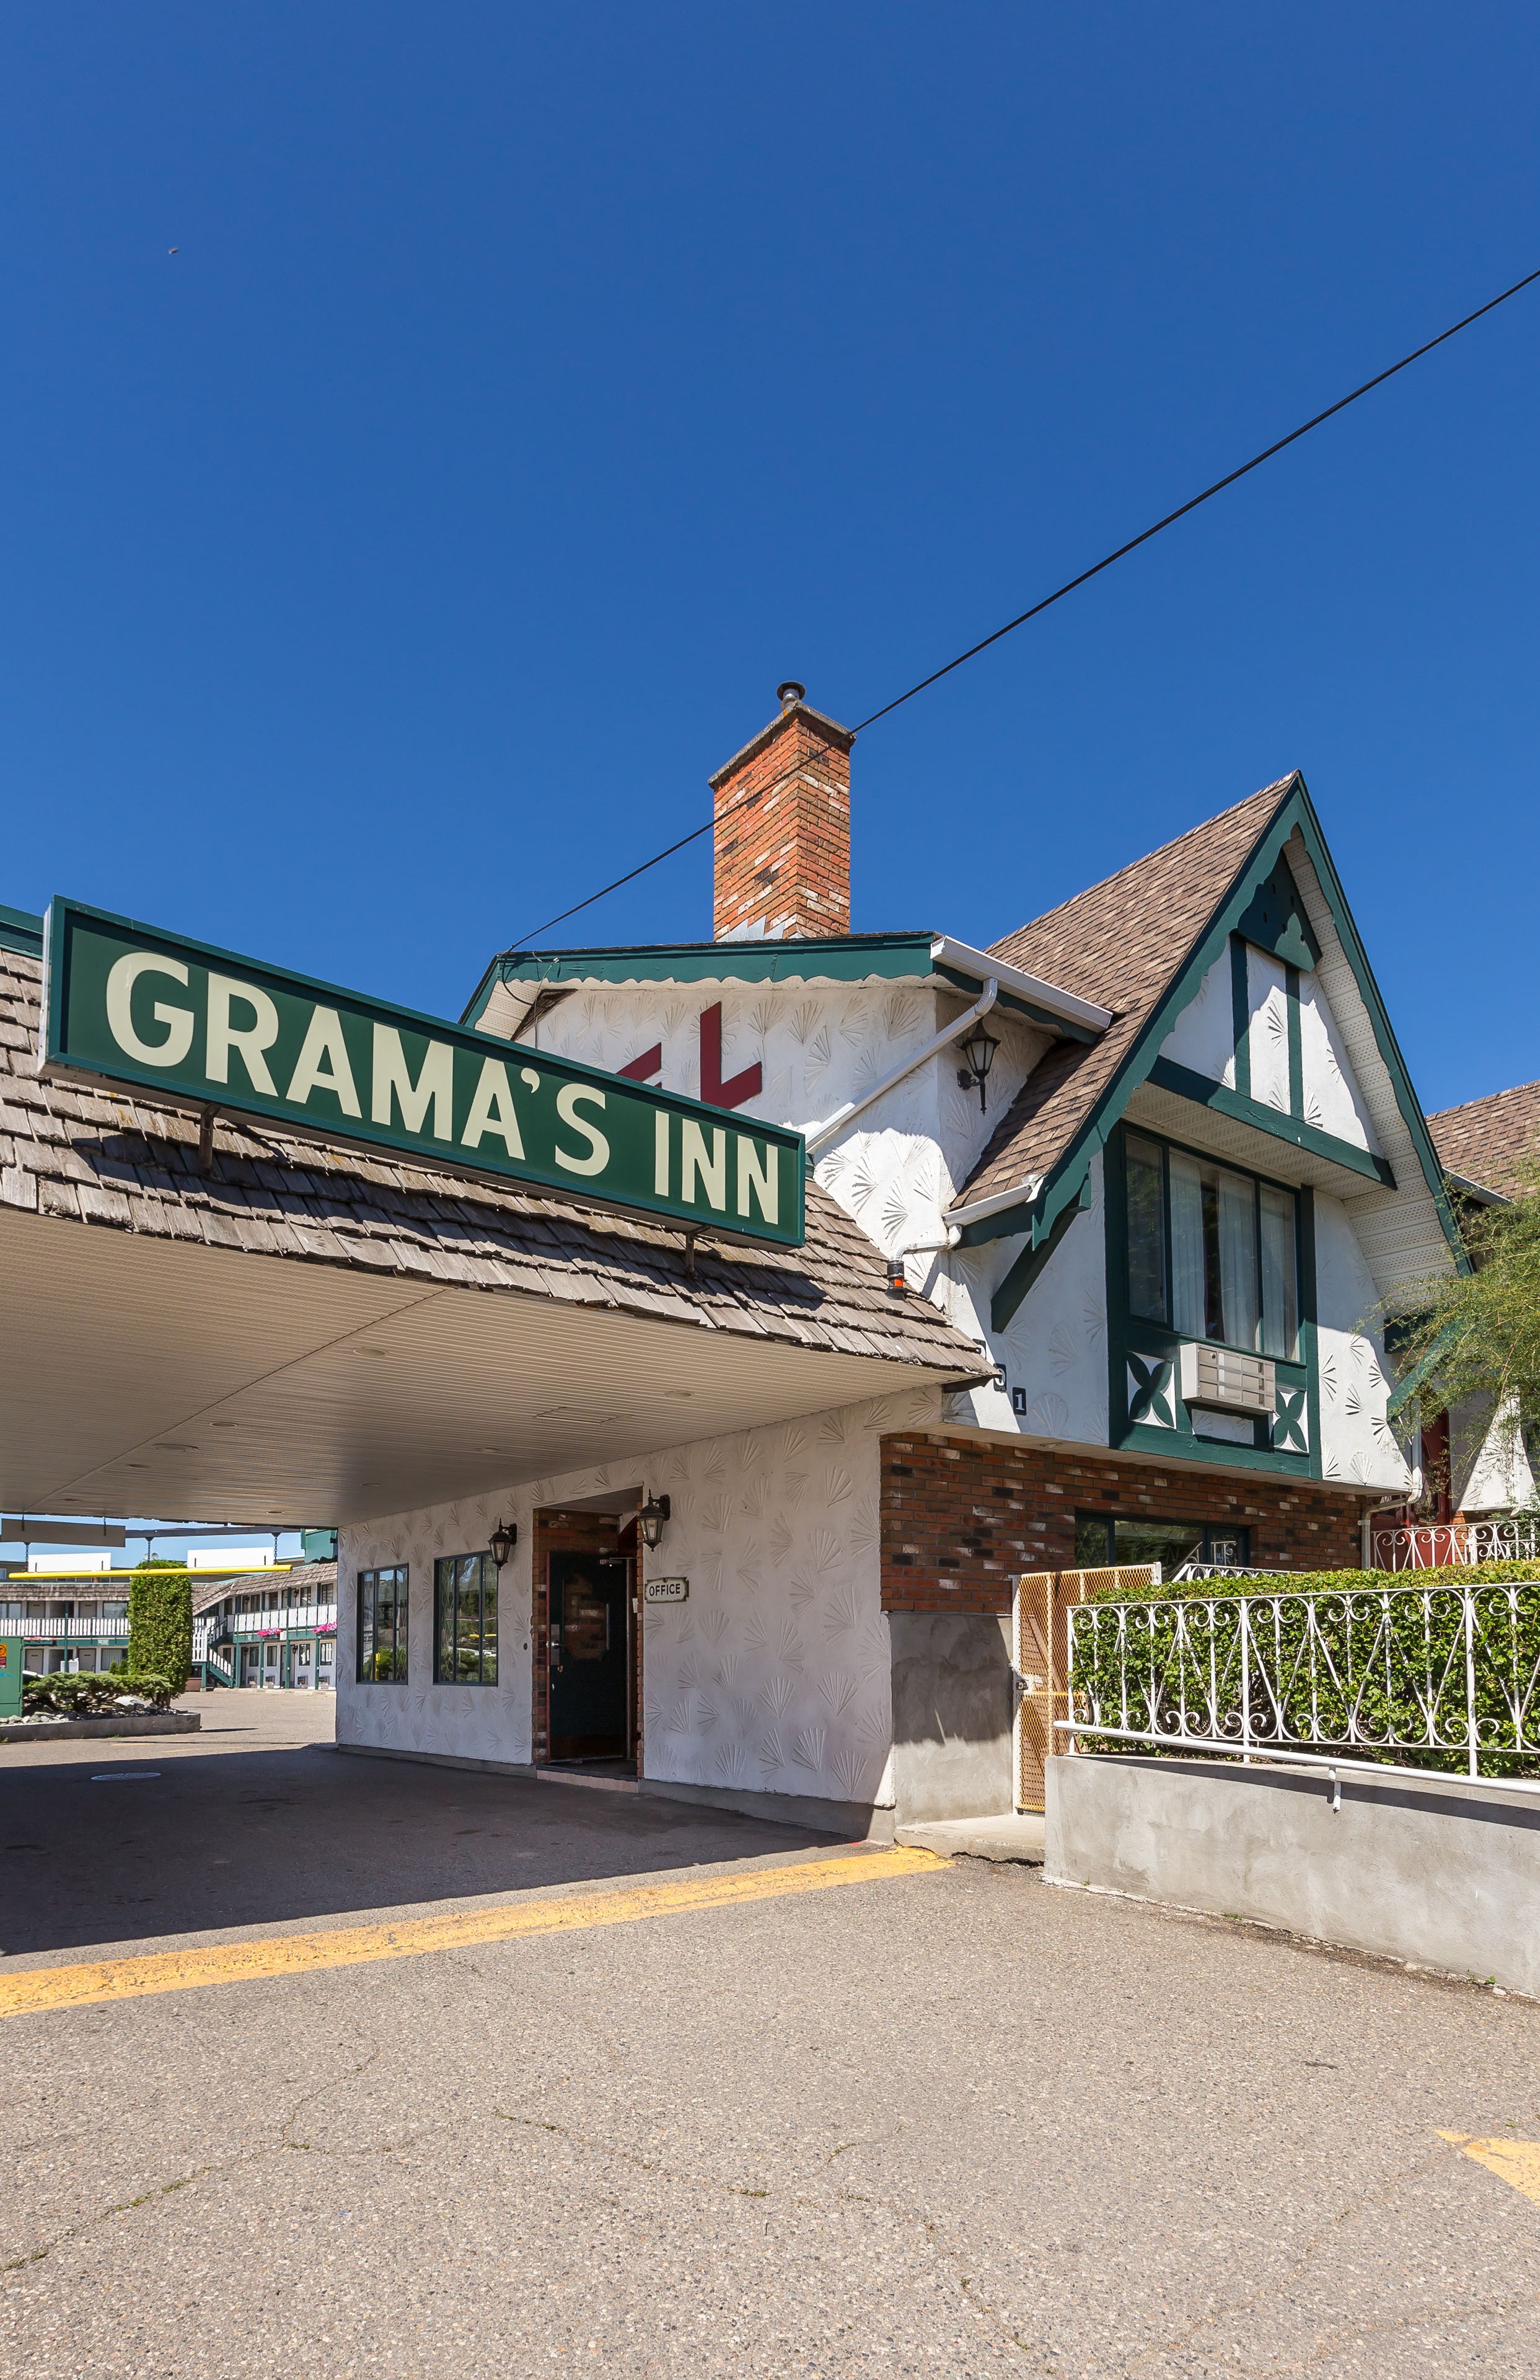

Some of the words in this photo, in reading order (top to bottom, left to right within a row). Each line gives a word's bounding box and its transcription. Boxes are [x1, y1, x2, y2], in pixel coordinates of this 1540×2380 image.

[107, 952, 610, 1176] GRAMA'S
[655, 1110, 779, 1225] INN
[649, 1584, 680, 1597] OFFICE
